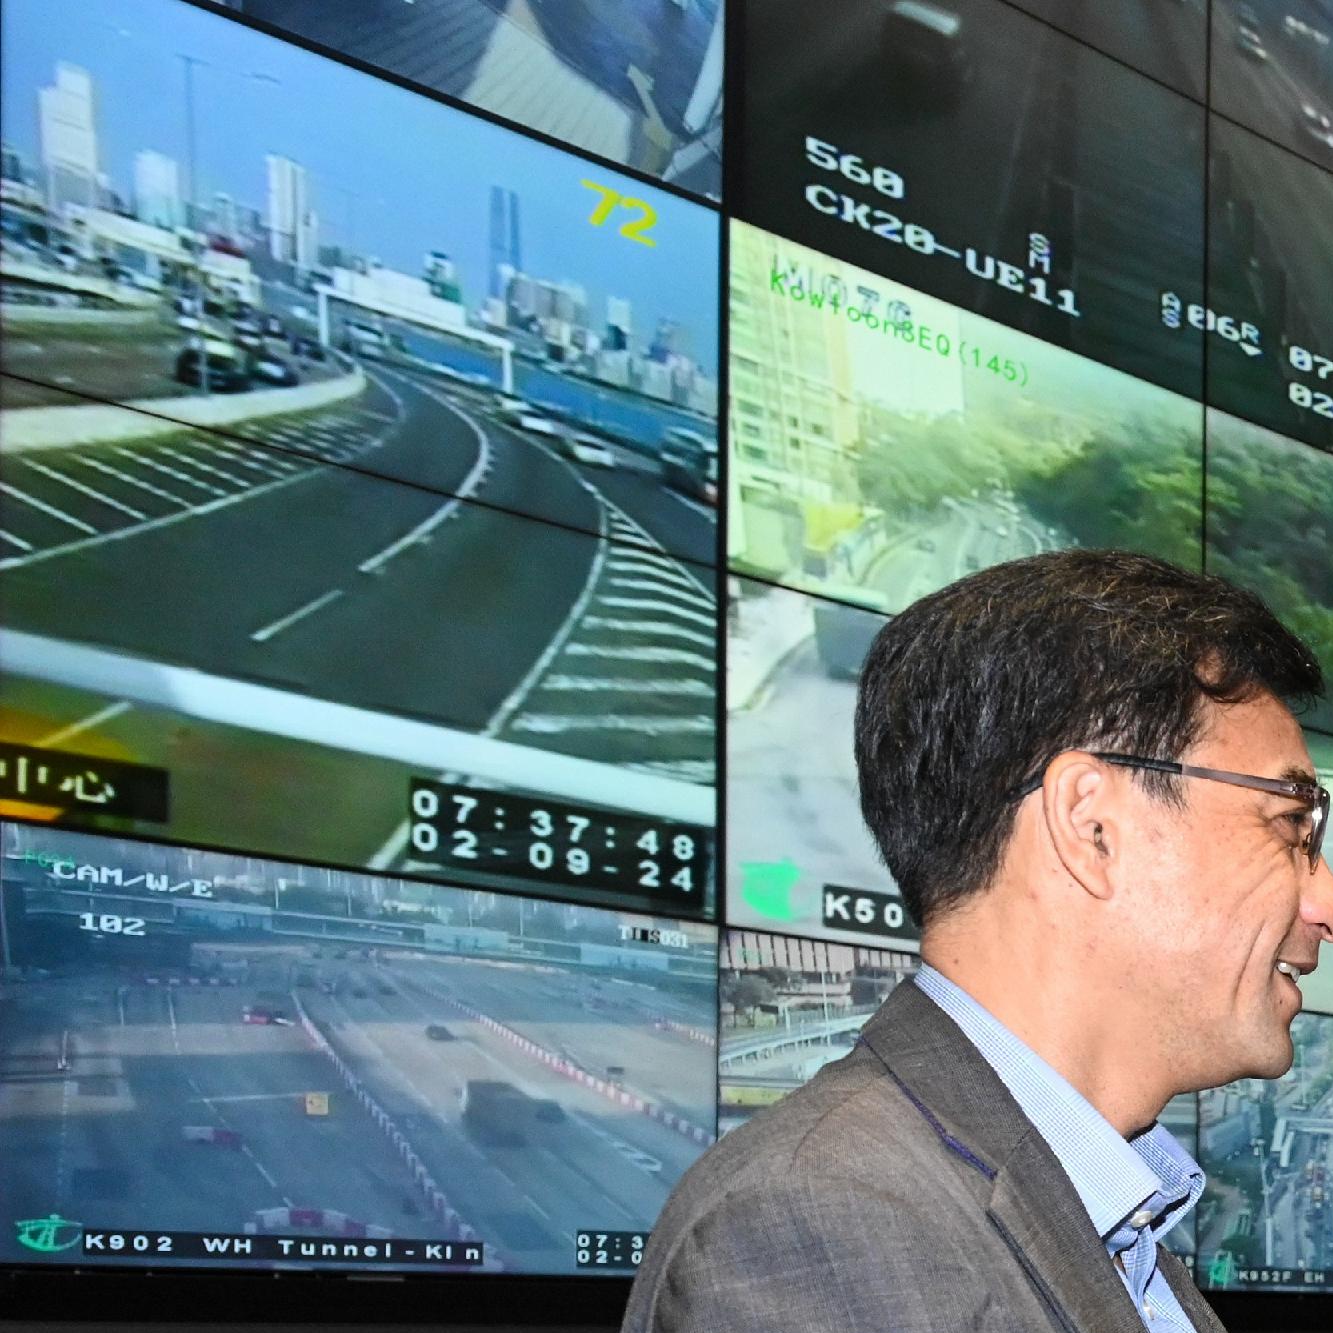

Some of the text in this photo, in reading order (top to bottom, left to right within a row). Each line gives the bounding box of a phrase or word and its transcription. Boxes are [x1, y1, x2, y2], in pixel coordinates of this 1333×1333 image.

[805, 136, 905, 199] 560
[580, 178, 657, 248] 72
[805, 184, 1081, 317] CK20-UE11
[412, 788, 695, 861] 07:37:48
[53, 860, 214, 899] CAM/W/E
[412, 822, 694, 892] 02-09-24
[79, 911, 147, 937] 102
[84, 1234, 173, 1252] K902
[202, 1237, 252, 1254] WH
[1304, 1271, 1325, 1284] EH
